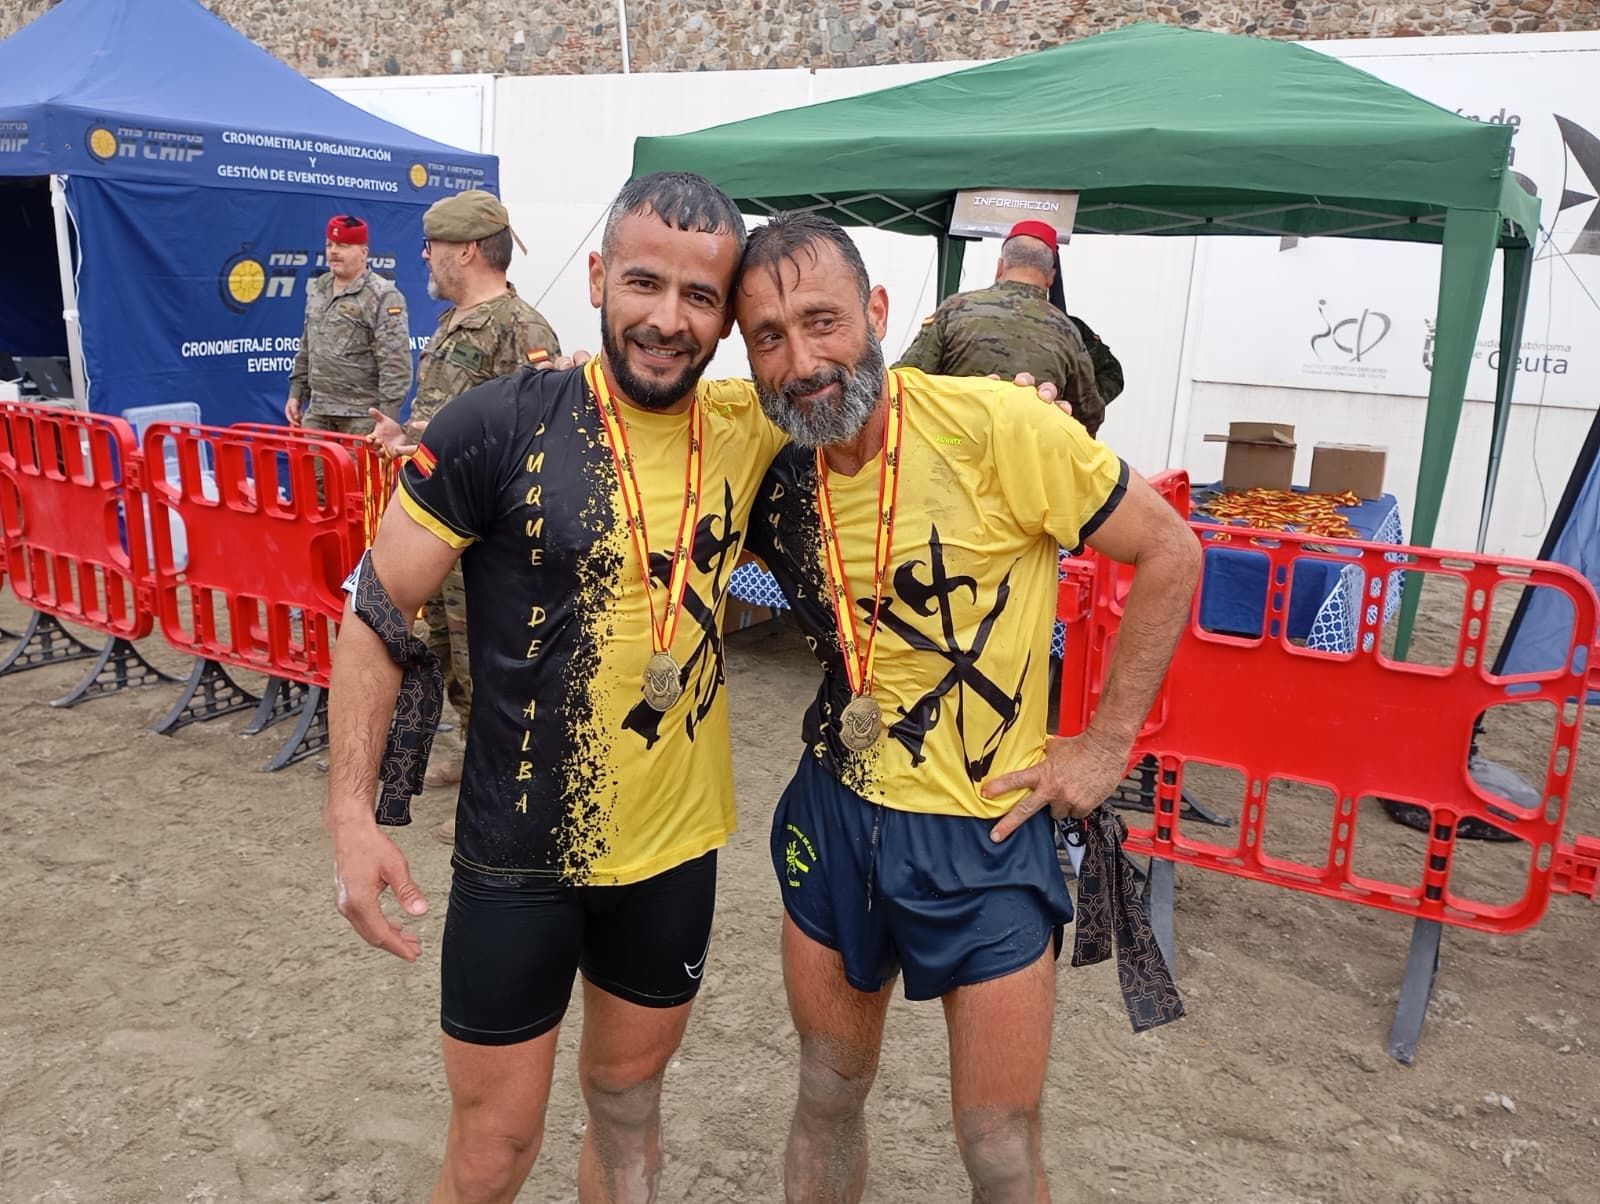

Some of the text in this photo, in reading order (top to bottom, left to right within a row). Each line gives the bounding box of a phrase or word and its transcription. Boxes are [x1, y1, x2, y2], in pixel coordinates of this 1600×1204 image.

[222, 131, 391, 162] CRONOMETRAJE ORGANIZACIÓN
[309, 157, 317, 168] Y
[217, 164, 398, 193] GESTIÓN DE EVENTOS DEPORTIVOS
[181, 338, 273, 358] CRONOMETRAJE
[527, 605, 546, 659] DE
[514, 697, 536, 815] ALBA
